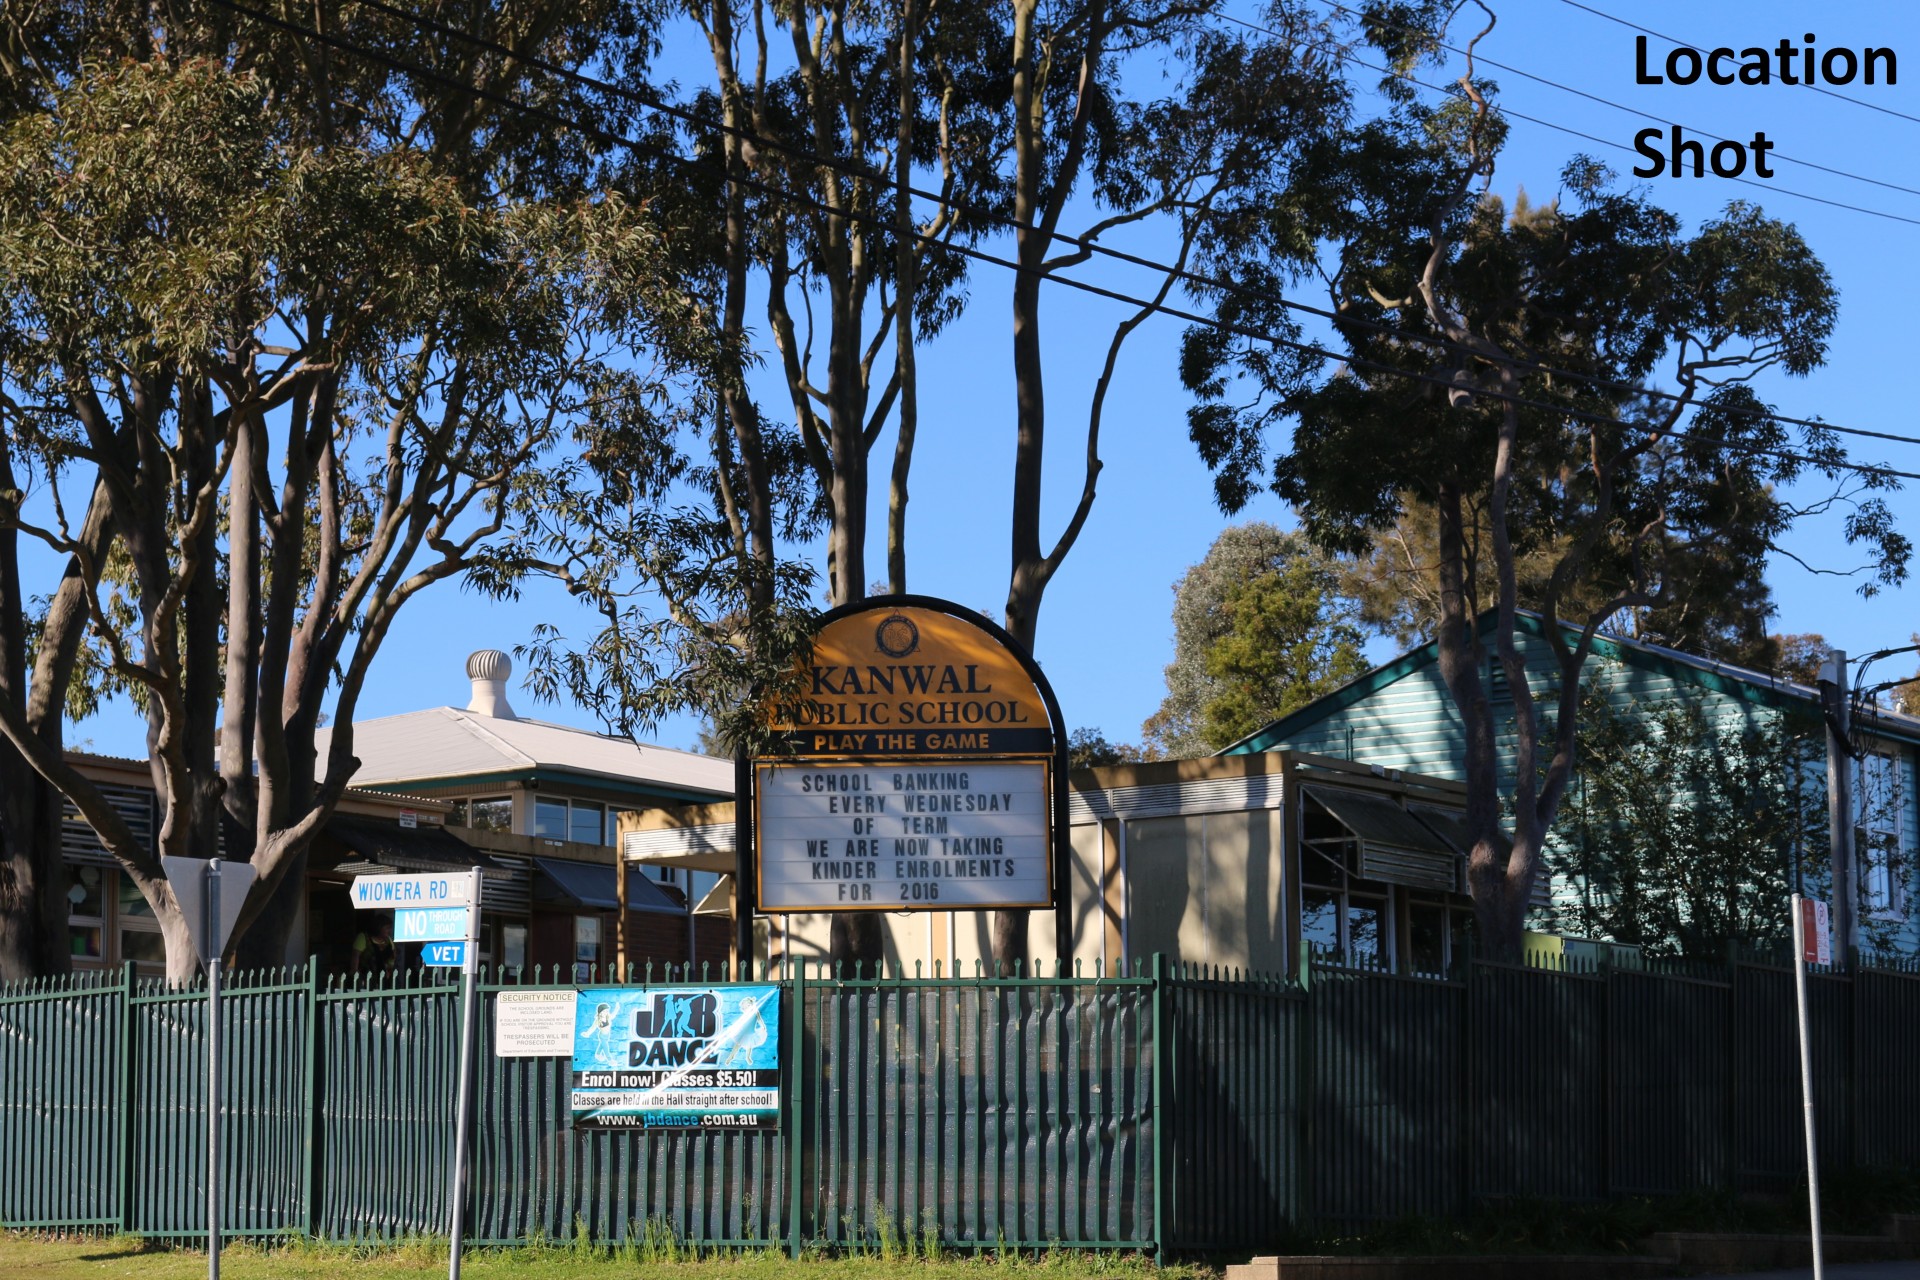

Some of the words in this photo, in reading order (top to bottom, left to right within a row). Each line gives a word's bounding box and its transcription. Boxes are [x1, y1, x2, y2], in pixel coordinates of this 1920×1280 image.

[810, 664, 992, 695] KANWAL
[898, 700, 1028, 724] SCHOOL
[814, 735, 865, 751] PLAY
[875, 734, 916, 750] THE
[925, 733, 990, 750] GAME
[801, 774, 872, 793] SCHOOL
[893, 772, 970, 791] BANKING
[829, 796, 886, 814] EVERY
[904, 793, 1012, 813] WEDNESDAY
[853, 817, 874, 836] OF
[902, 816, 948, 835] TERM
[806, 839, 829, 858] WE
[845, 839, 879, 857] ARE
[894, 838, 929, 857] NOW
[941, 837, 1004, 856] TAKING
[811, 861, 877, 880] KINDER
[895, 858, 1015, 879] ENROLMENTS
[358, 881, 421, 902] WIOWERA
[429, 880, 448, 900] RD
[838, 883, 872, 901] FOR
[900, 882, 939, 900] 2016
[404, 911, 427, 936] NO
[429, 910, 463, 921] THROUGH
[434, 923, 456, 934] ROAD
[432, 946, 460, 962] VET
[502, 994, 541, 1002] SECURITY
[543, 993, 573, 1001] NOTICE
[629, 1040, 719, 1067] DANCE
[581, 1071, 617, 1087] Enrol
[620, 1071, 656, 1087] now!
[661, 1071, 713, 1087] Casses
[716, 1069, 757, 1088] $5.50!
[573, 1093, 605, 1105] Classes
[607, 1096, 621, 1105] are
[623, 1093, 641, 1105] held
[651, 1094, 665, 1105] the
[667, 1093, 683, 1105] Hall
[685, 1093, 718, 1108] straight
[719, 1093, 739, 1105] after
[740, 1092, 773, 1105] school!
